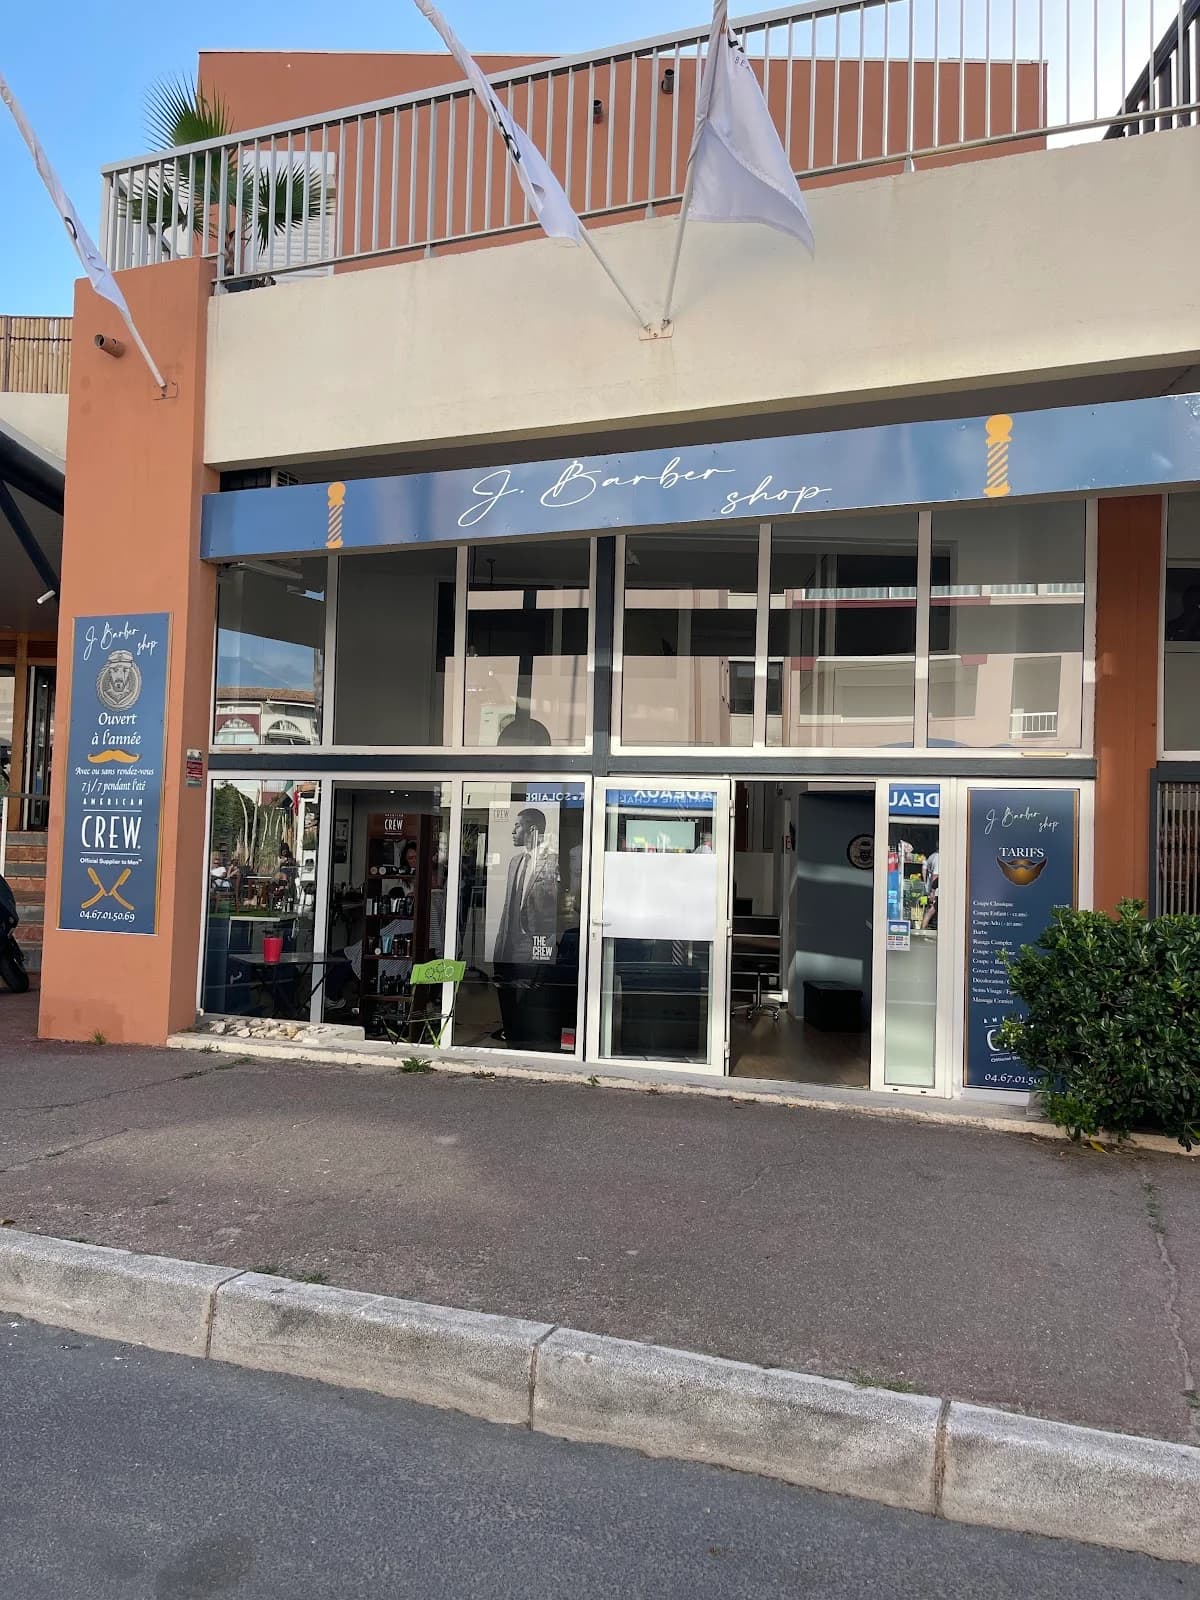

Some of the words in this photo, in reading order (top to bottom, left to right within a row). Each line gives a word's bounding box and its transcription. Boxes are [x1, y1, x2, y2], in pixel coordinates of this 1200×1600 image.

[540, 457, 736, 507] Barber
[721, 475, 832, 514] shop
[101, 621, 139, 650] Barber
[137, 633, 158, 656] shop
[98, 712, 136, 725] Ouvert
[91, 732, 98, 745] à
[102, 729, 142, 745] l'année
[75, 767, 89, 775] Avec
[117, 766, 154, 775] rendez-vous
[101, 777, 131, 795] pendant
[83, 798, 143, 806] AMERICAN
[1001, 806, 1040, 828] Barber
[1039, 816, 1060, 832] shop
[384, 819, 404, 831] CREW
[998, 847, 1044, 857] TARIFS
[79, 910, 135, 922] 04.67.01.50.69
[532, 935, 546, 946] THE
[532, 946, 553, 956] CREW
